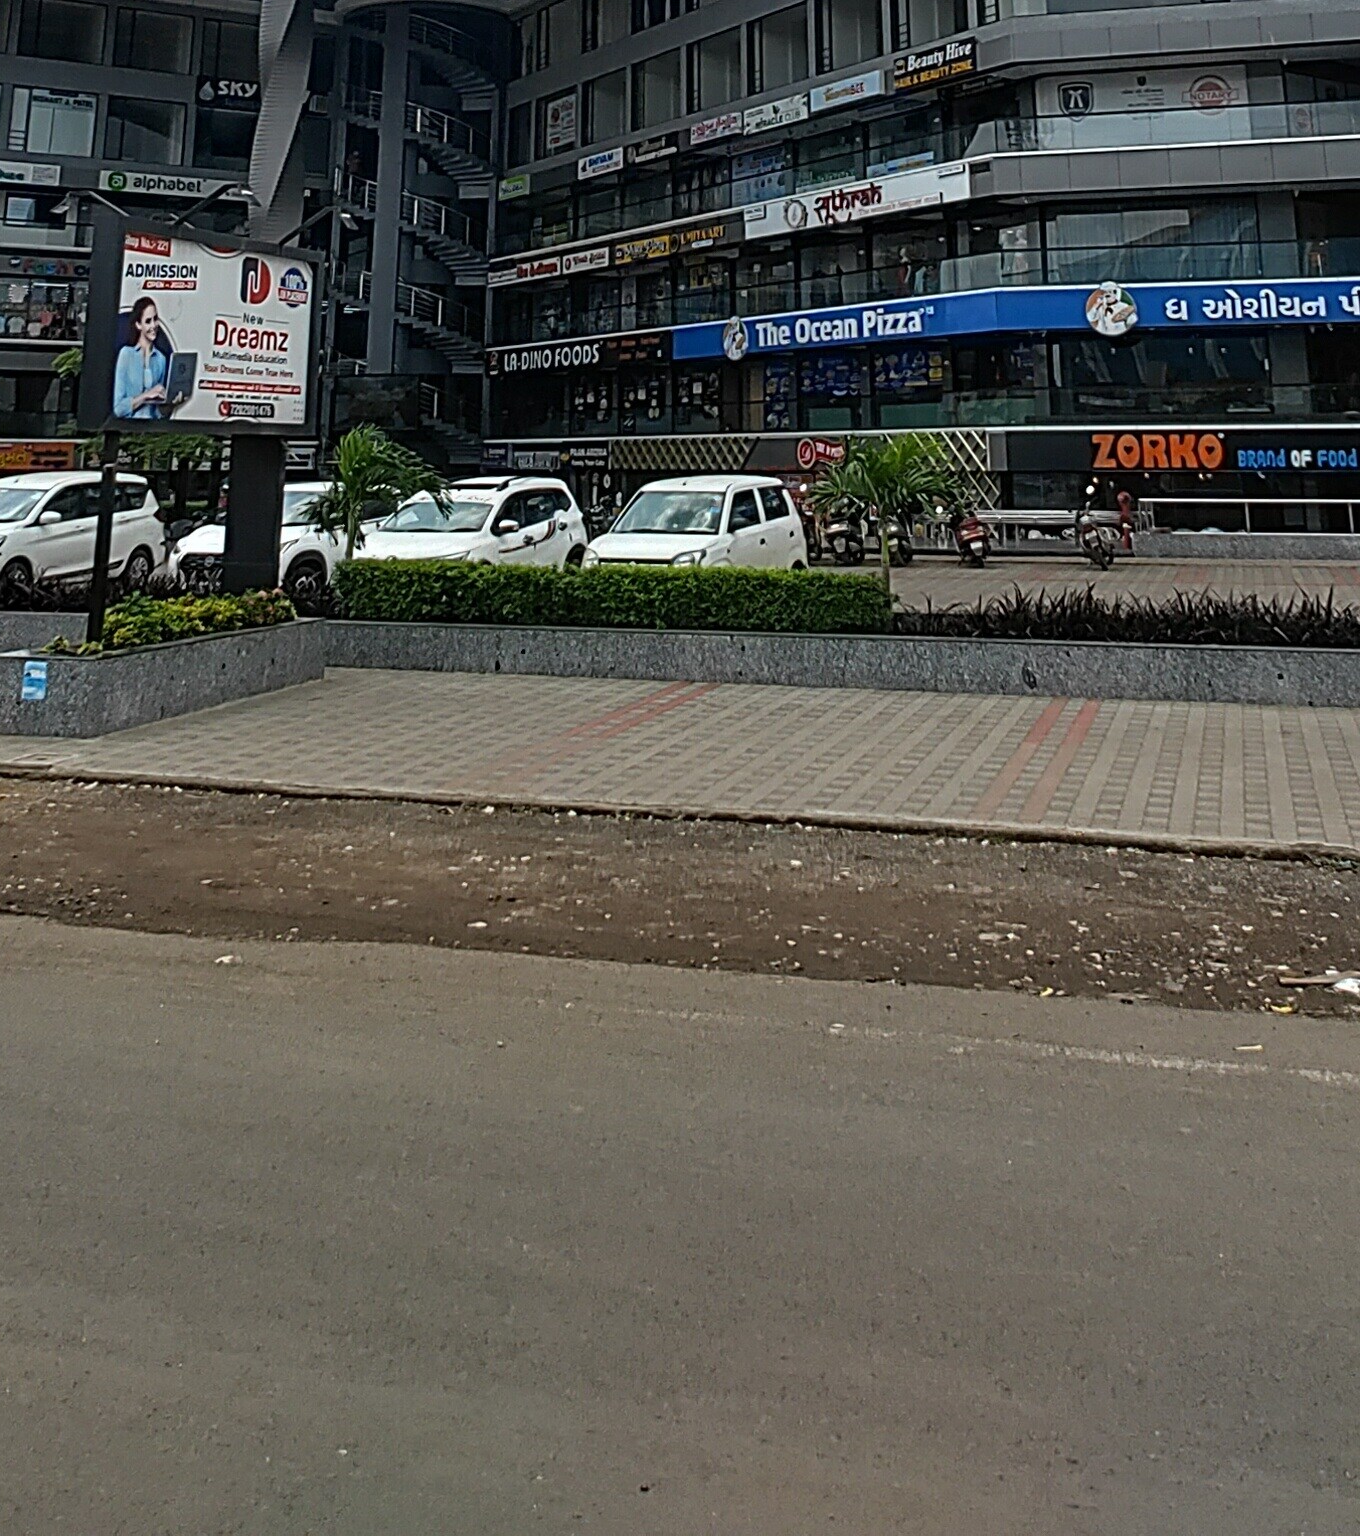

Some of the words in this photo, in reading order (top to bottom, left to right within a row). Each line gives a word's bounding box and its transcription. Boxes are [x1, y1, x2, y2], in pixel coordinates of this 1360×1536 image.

[907, 51, 945, 71] Beauty
[946, 43, 973, 61] Hive
[1190, 91, 1232, 101] NOTARY
[125, 263, 199, 279] ADMISSION
[1165, 297, 1189, 321] ધ
[1202, 287, 1327, 319] ઓશીયન
[243, 312, 264, 325] New
[756, 321, 791, 348] The
[794, 317, 858, 344] Ocean
[862, 308, 923, 337] Pizza
[213, 319, 290, 352] Dreamz
[212, 350, 253, 362] Multimedia
[253, 354, 288, 365] Education
[554, 344, 600, 368] FOODS
[245, 367, 264, 376] Come
[1092, 433, 1223, 469] ZORKO
[1291, 448, 1313, 467] OF
